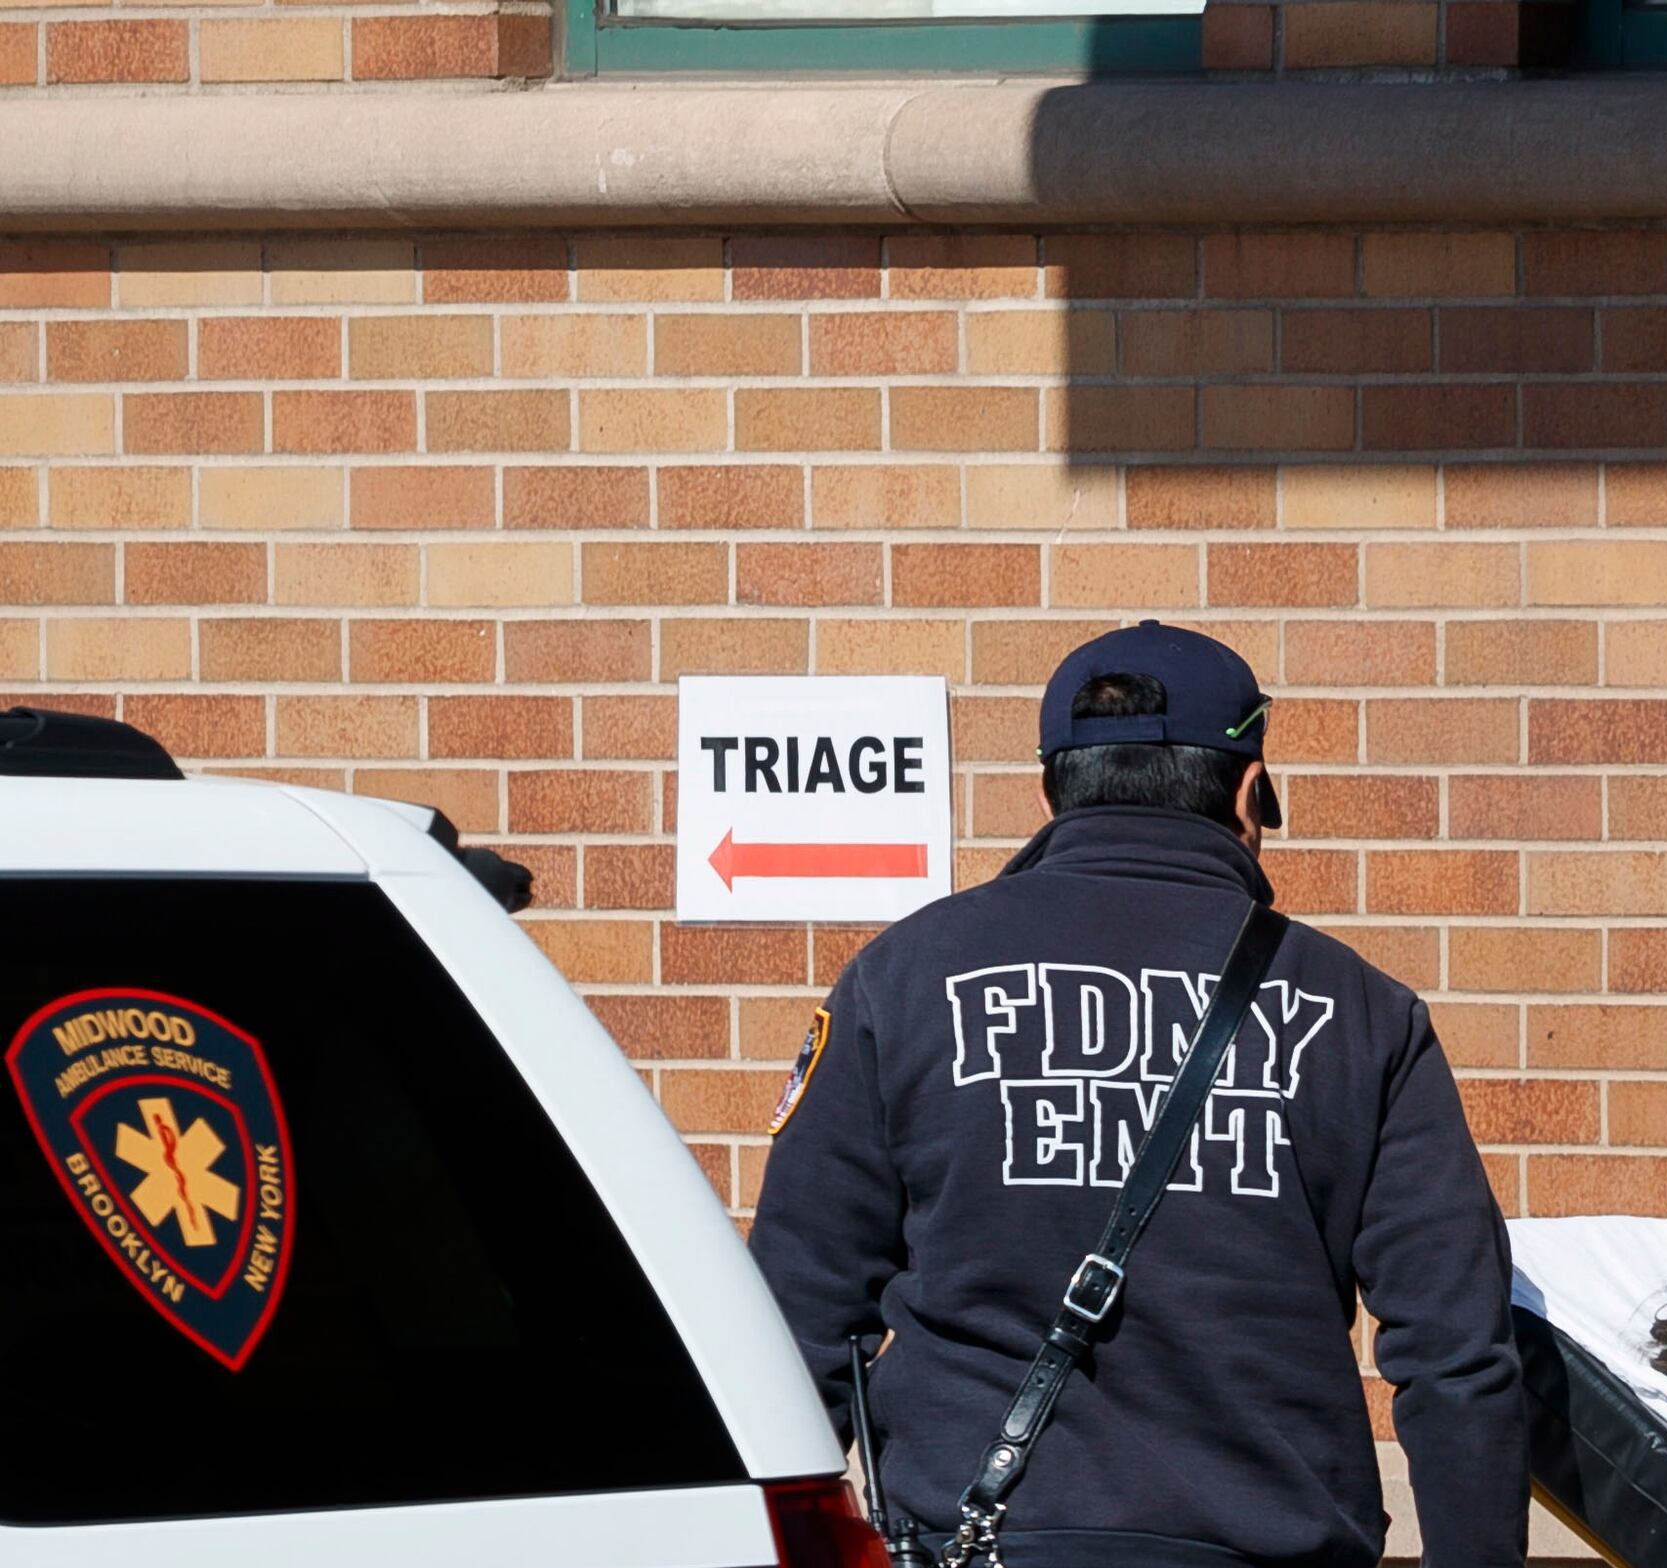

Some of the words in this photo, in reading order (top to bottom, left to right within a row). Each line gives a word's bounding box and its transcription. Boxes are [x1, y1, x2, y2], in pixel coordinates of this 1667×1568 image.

[700, 736, 925, 794] TRIAGE
[52, 1008, 196, 1056] MIDWOOD
[945, 962, 1334, 1099] FDNY
[54, 1044, 149, 1098] AMBULANCE
[151, 1045, 232, 1090] SERVICE
[999, 1079, 1292, 1199] EMT
[257, 1143, 282, 1220] YORK
[65, 1153, 186, 1303] BROOKLYN
[243, 1225, 281, 1292] NEW
